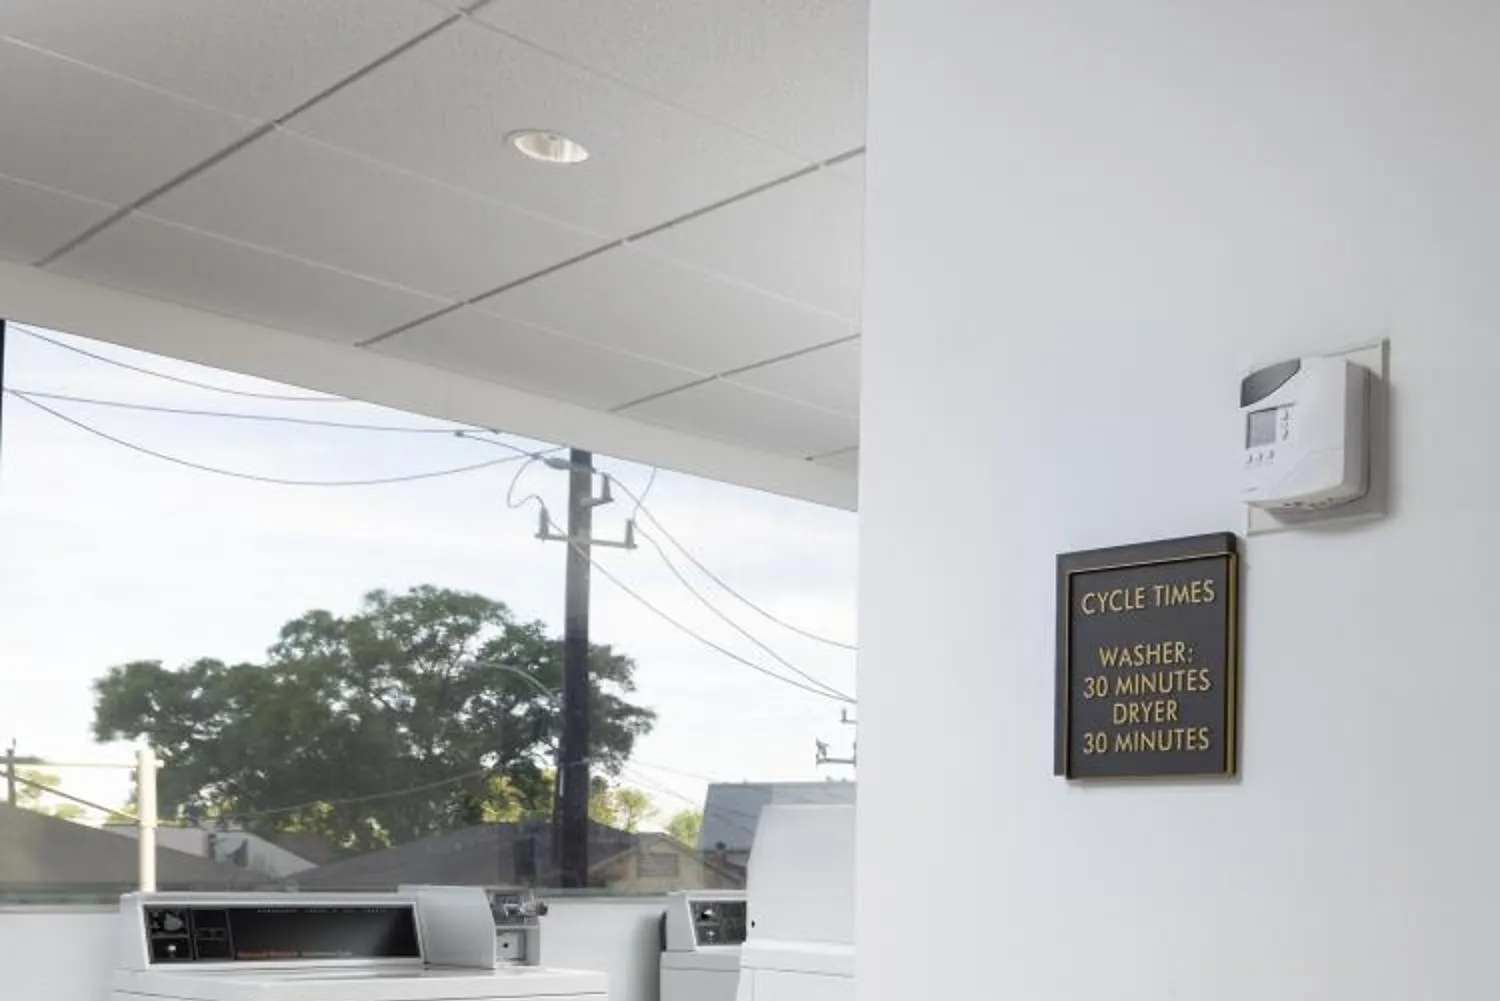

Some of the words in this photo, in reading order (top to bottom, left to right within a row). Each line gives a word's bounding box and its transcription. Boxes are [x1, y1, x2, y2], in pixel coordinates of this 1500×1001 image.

[1081, 587, 1146, 615] CYCLE
[1153, 580, 1215, 607] TIMES
[1099, 641, 1193, 667] WASHER:
[1083, 677, 1108, 699] 30
[1115, 669, 1211, 696] MINUTES
[1113, 700, 1178, 725] DRYER
[1083, 733, 1108, 755] 30
[1115, 728, 1210, 753] MINUTES
